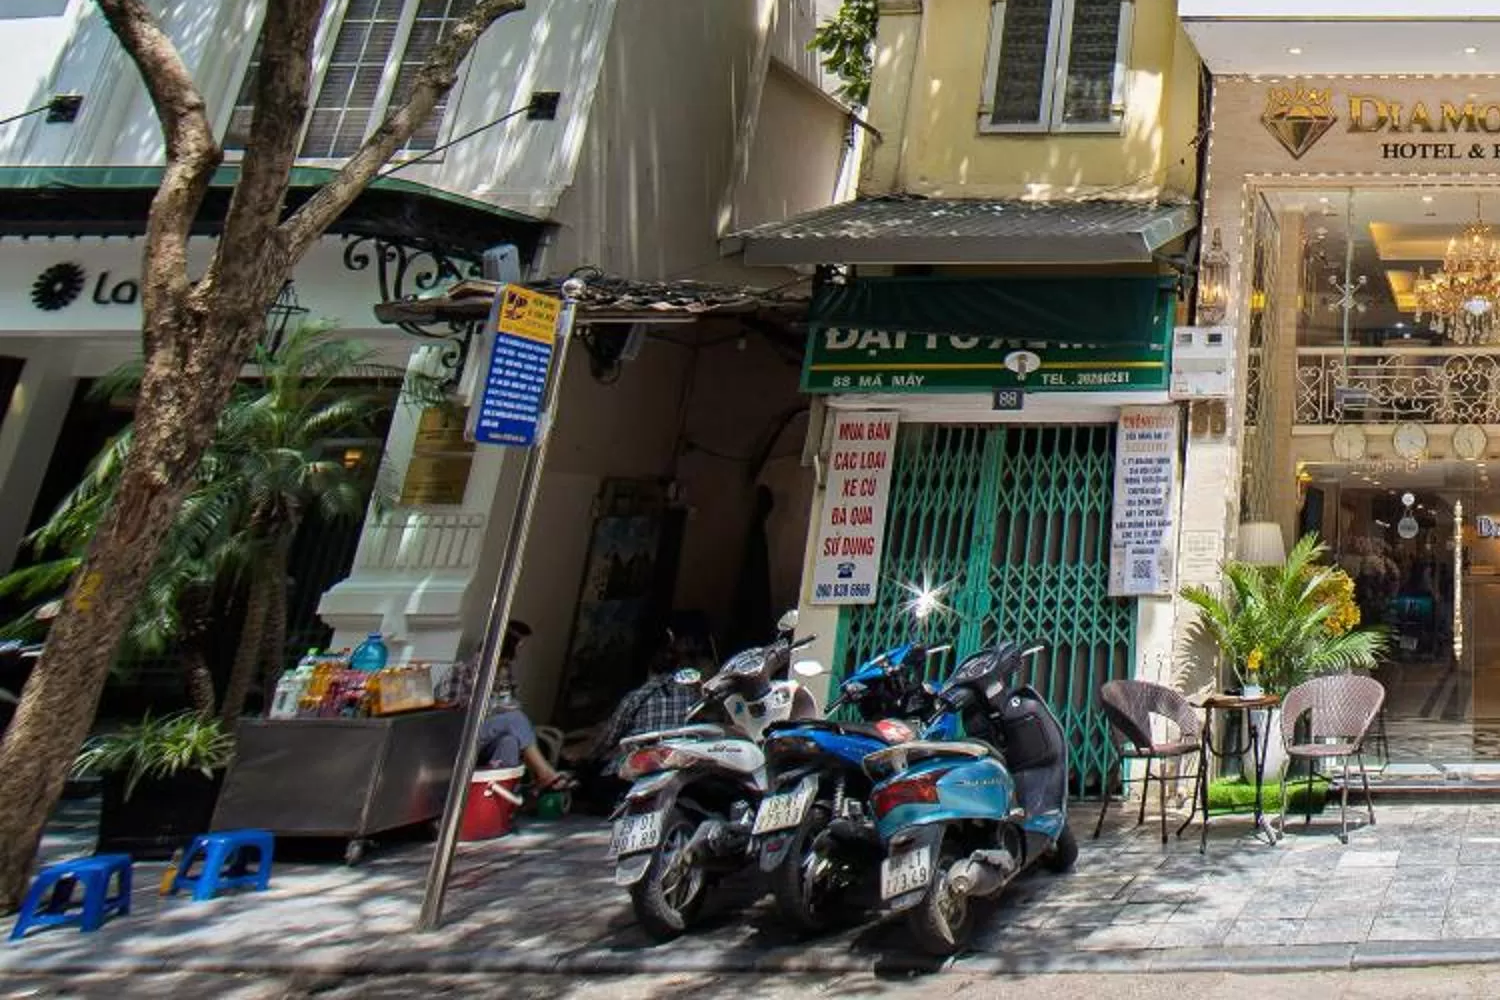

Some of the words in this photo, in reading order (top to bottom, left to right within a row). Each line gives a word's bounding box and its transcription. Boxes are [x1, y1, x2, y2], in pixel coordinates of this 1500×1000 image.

[1382, 143, 1460, 160] HOTEL
[1468, 143, 1486, 160] &
[999, 391, 1017, 408] 88
[839, 423, 864, 441] MUA
[859, 451, 887, 472] LOẠI
[842, 479, 857, 497] XE
[849, 505, 873, 526] QUA
